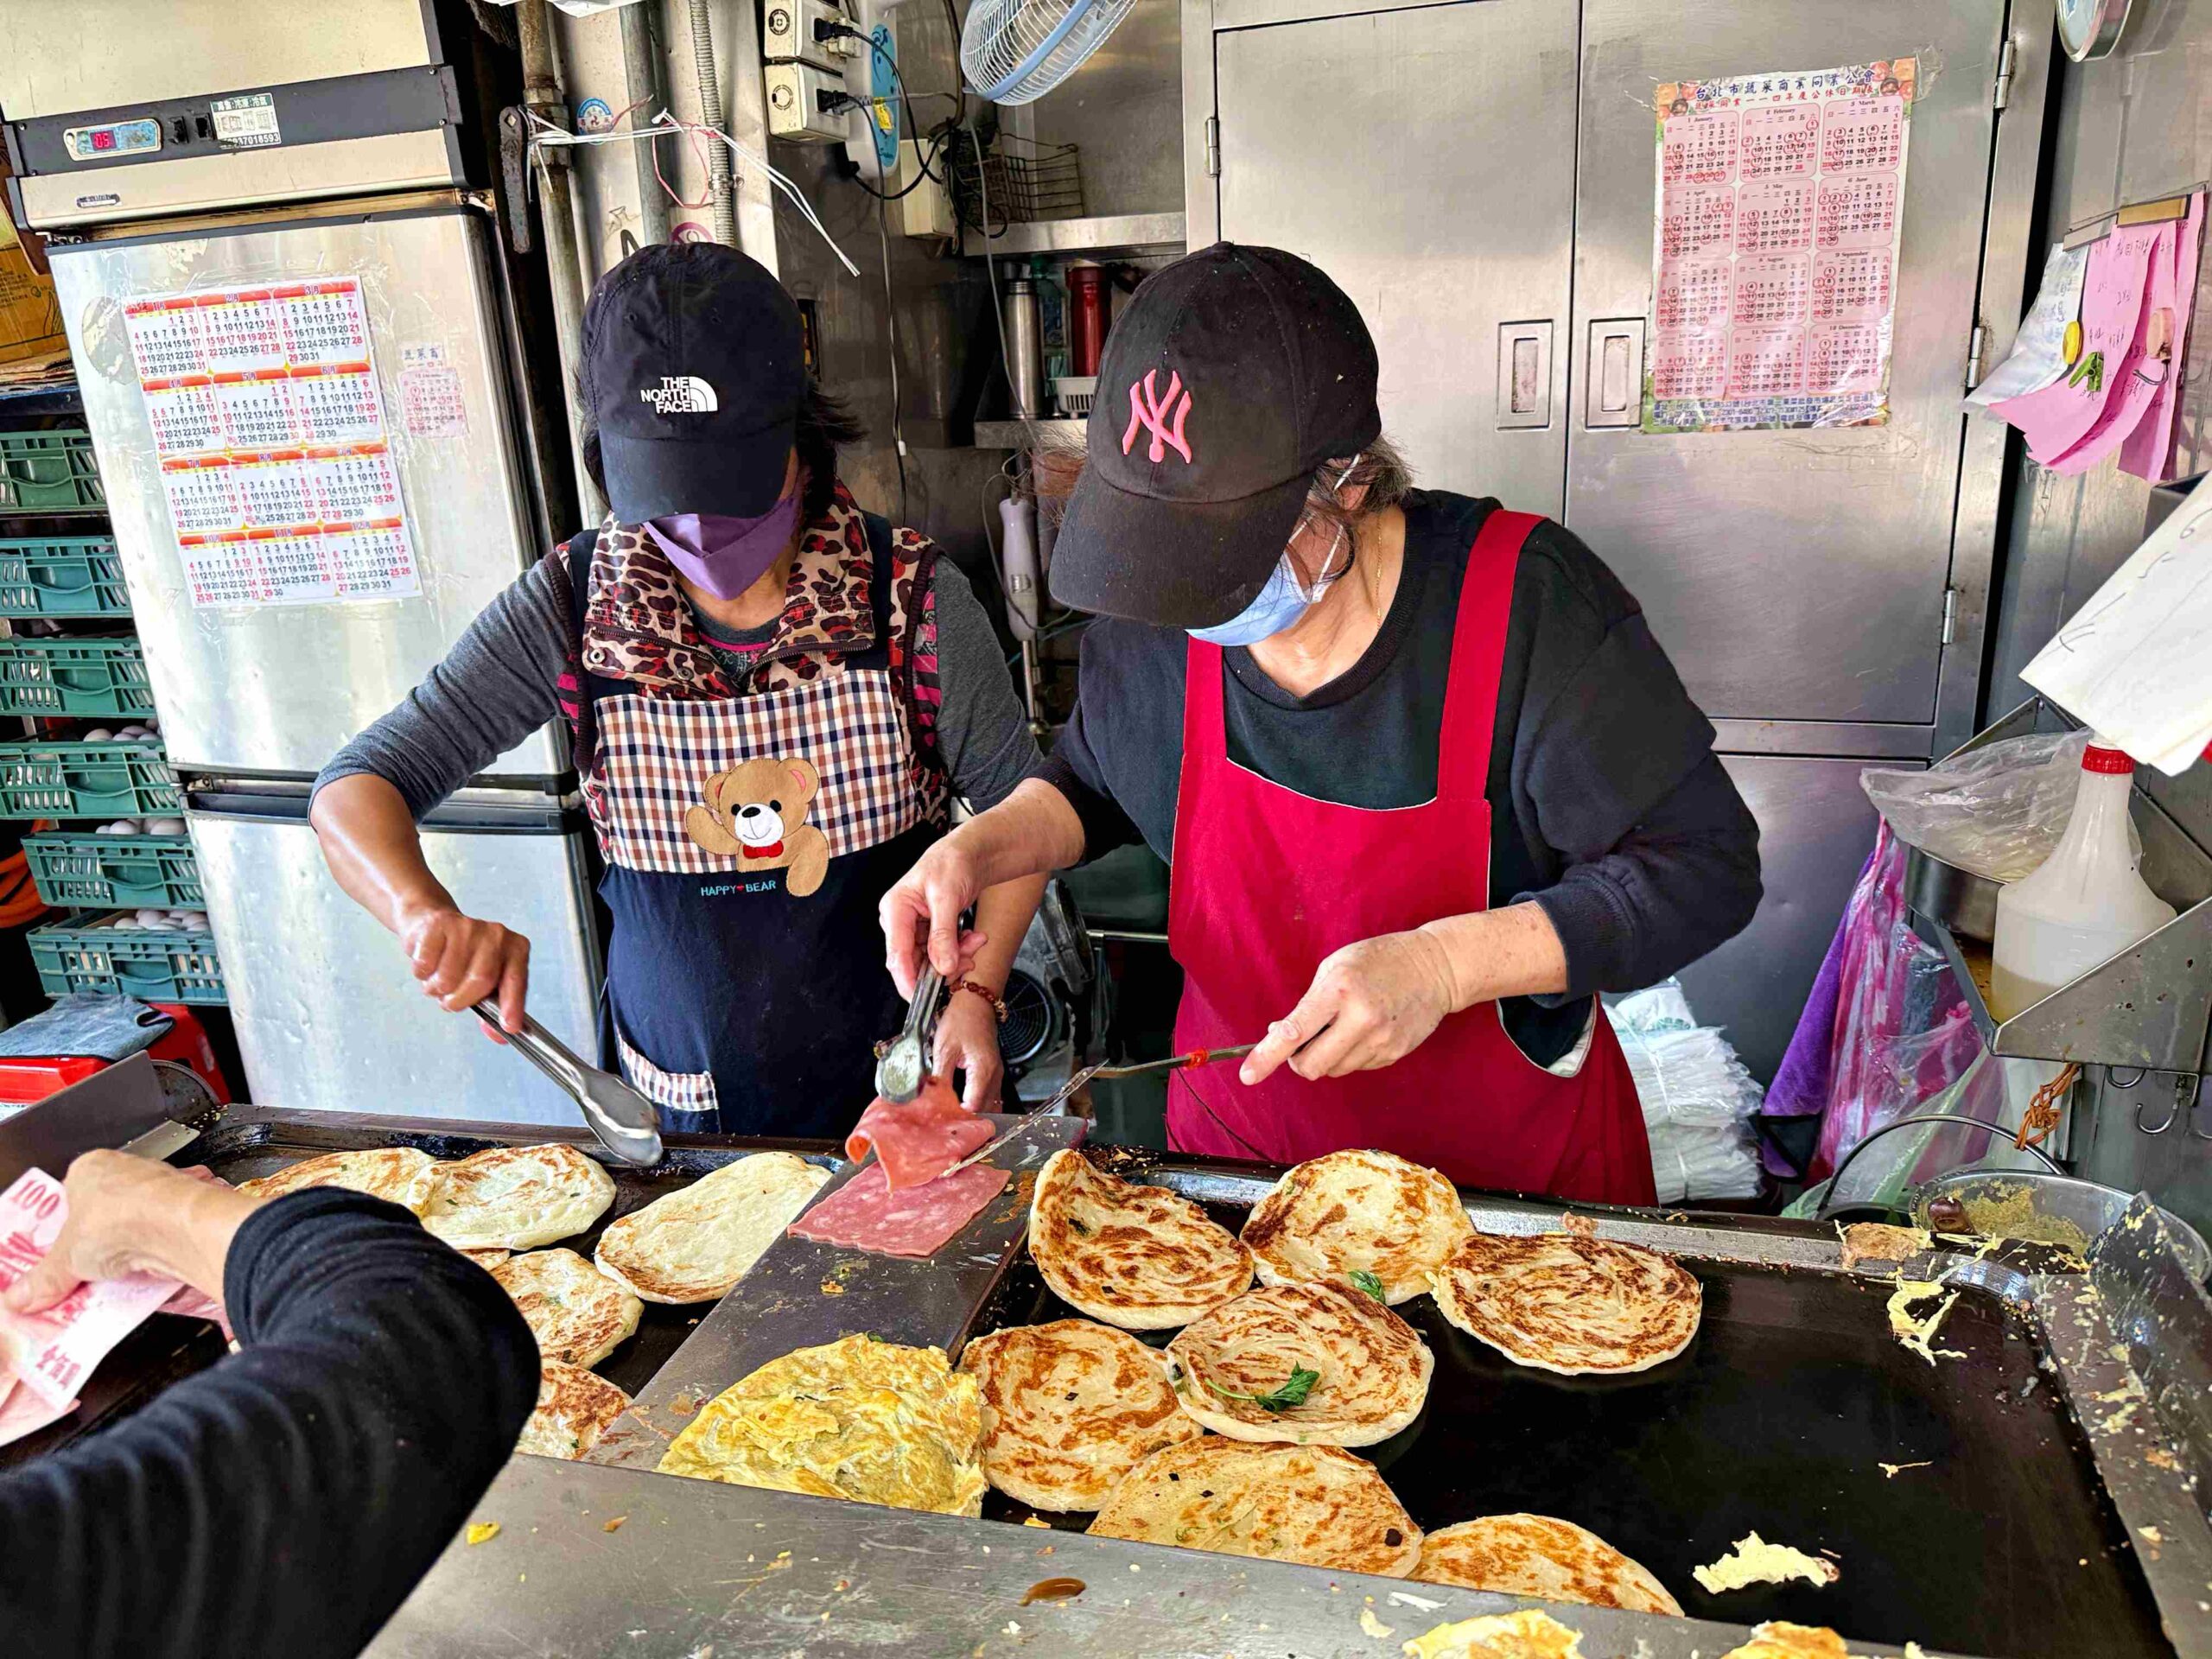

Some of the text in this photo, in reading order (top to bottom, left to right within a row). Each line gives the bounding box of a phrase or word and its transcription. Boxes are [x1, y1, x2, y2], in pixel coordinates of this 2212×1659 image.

[294, 328, 304, 337] 16
[327, 326, 337, 334] 19
[144, 342, 153, 351] 12
[163, 340, 172, 349] 14
[228, 346, 238, 355] 24
[260, 344, 269, 353] 27
[660, 376, 690, 389] THE
[640, 388, 690, 402] NORTH
[655, 400, 692, 414] FACE
[324, 417, 334, 426] 23
[1122, 369, 1192, 464] NY
[390, 568, 399, 576] 25
[701, 880, 777, 897] HAPPY BEAR
[11, 1179, 60, 1220] 100
